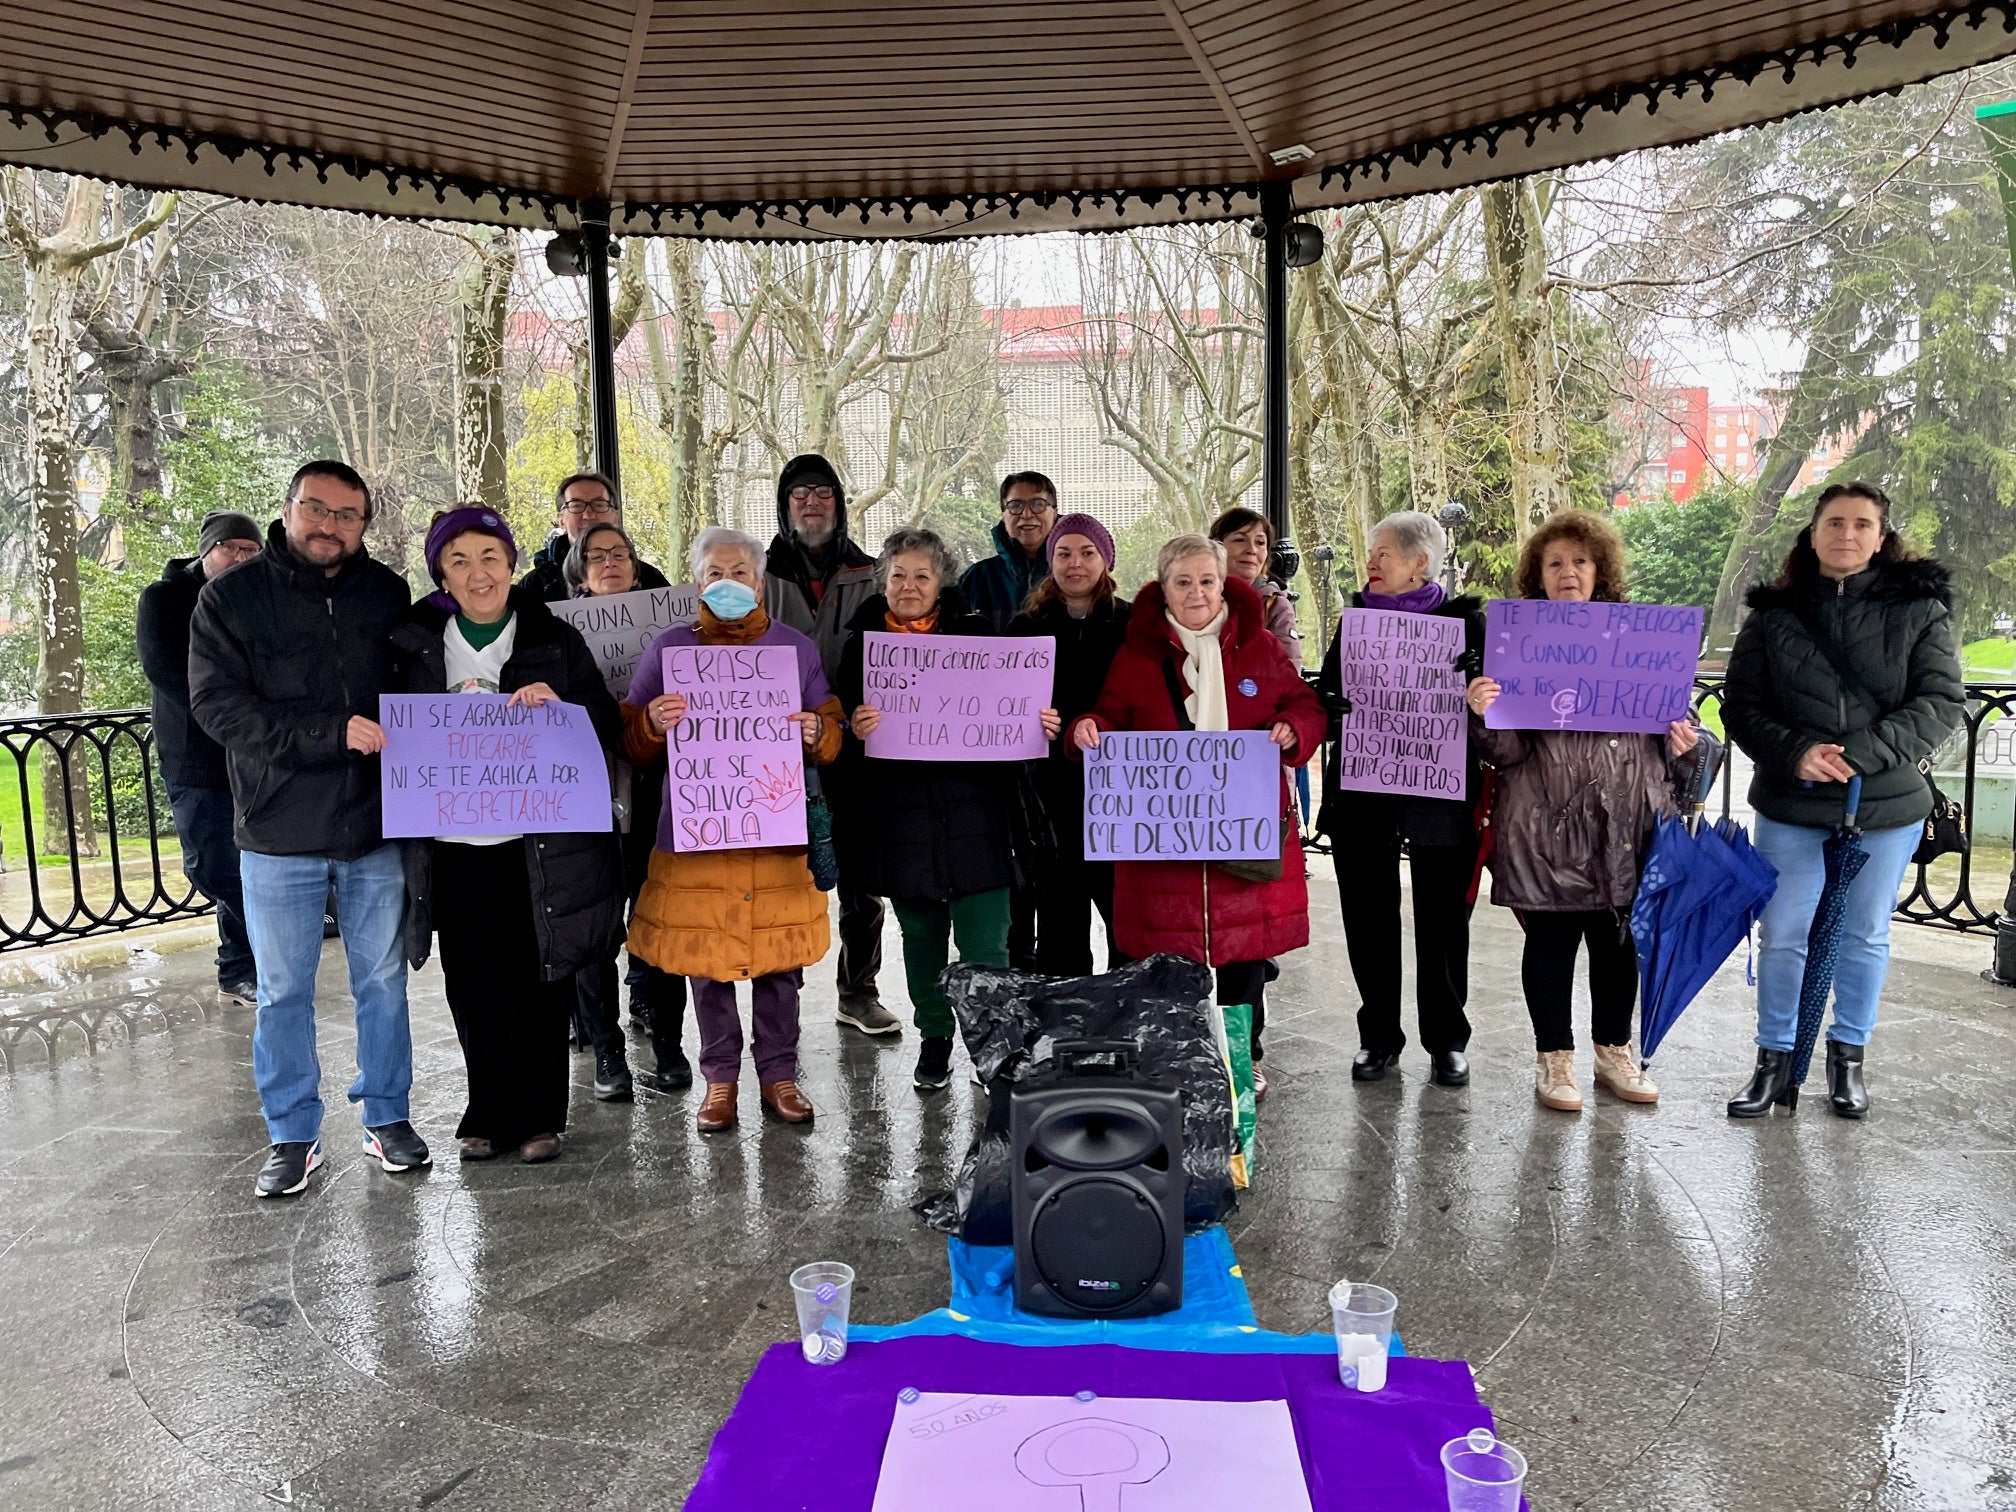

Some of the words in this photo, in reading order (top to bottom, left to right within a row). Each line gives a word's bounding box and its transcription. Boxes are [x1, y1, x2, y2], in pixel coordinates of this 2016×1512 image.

[650, 590, 700, 623] MUJE
[1500, 602, 1520, 625] TE
[1606, 604, 1697, 634] PRECIOSA
[1350, 615, 1368, 636] EL
[1378, 616, 1460, 646] FEMINISMO
[603, 643, 624, 660] UN
[904, 645, 940, 672] mujer
[994, 650, 1018, 670] ser
[1024, 648, 1050, 668] dos
[1344, 640, 1367, 660] NO
[1369, 640, 1392, 661] SE
[1395, 642, 1434, 664] BASA
[671, 648, 775, 684] ERASE
[1344, 663, 1389, 688] ODIAR
[1394, 666, 1412, 688] AL
[868, 670, 916, 689] cosas:
[719, 690, 752, 710] VEZ
[757, 690, 790, 708] UNA
[868, 692, 920, 714] QUIEN
[938, 695, 951, 714] Y
[958, 696, 980, 716] LO
[998, 696, 1032, 716] QUE
[1370, 690, 1420, 714] LUCHAR
[1574, 678, 1691, 723] DERECHOS
[390, 704, 412, 728] NI
[430, 704, 452, 728] SE
[461, 703, 534, 726] AGRANDA
[1346, 709, 1364, 730] LA
[1369, 711, 1460, 740] ABSURDA
[674, 710, 794, 753] princesa
[908, 722, 949, 746] ELLA
[962, 723, 1024, 747] QUIERA
[448, 732, 542, 760] PUTEARME
[1125, 736, 1178, 763] ELIJO
[391, 766, 408, 788] NI
[418, 766, 438, 788] SE
[450, 766, 472, 786] TE
[478, 764, 538, 786] ACHICA
[552, 766, 579, 784] POR
[675, 757, 715, 780] QUE
[728, 755, 754, 778] SE
[1088, 765, 1118, 790] ME
[1122, 765, 1192, 790] VISTO
[1380, 759, 1460, 794] GÉNEROS
[436, 789, 572, 827] RESPETARME
[1088, 794, 1132, 816] CON
[681, 812, 761, 850] SOLA
[1088, 822, 1124, 854] ME
[1134, 817, 1272, 854] DESVISTO
[909, 1420, 944, 1438] 50
